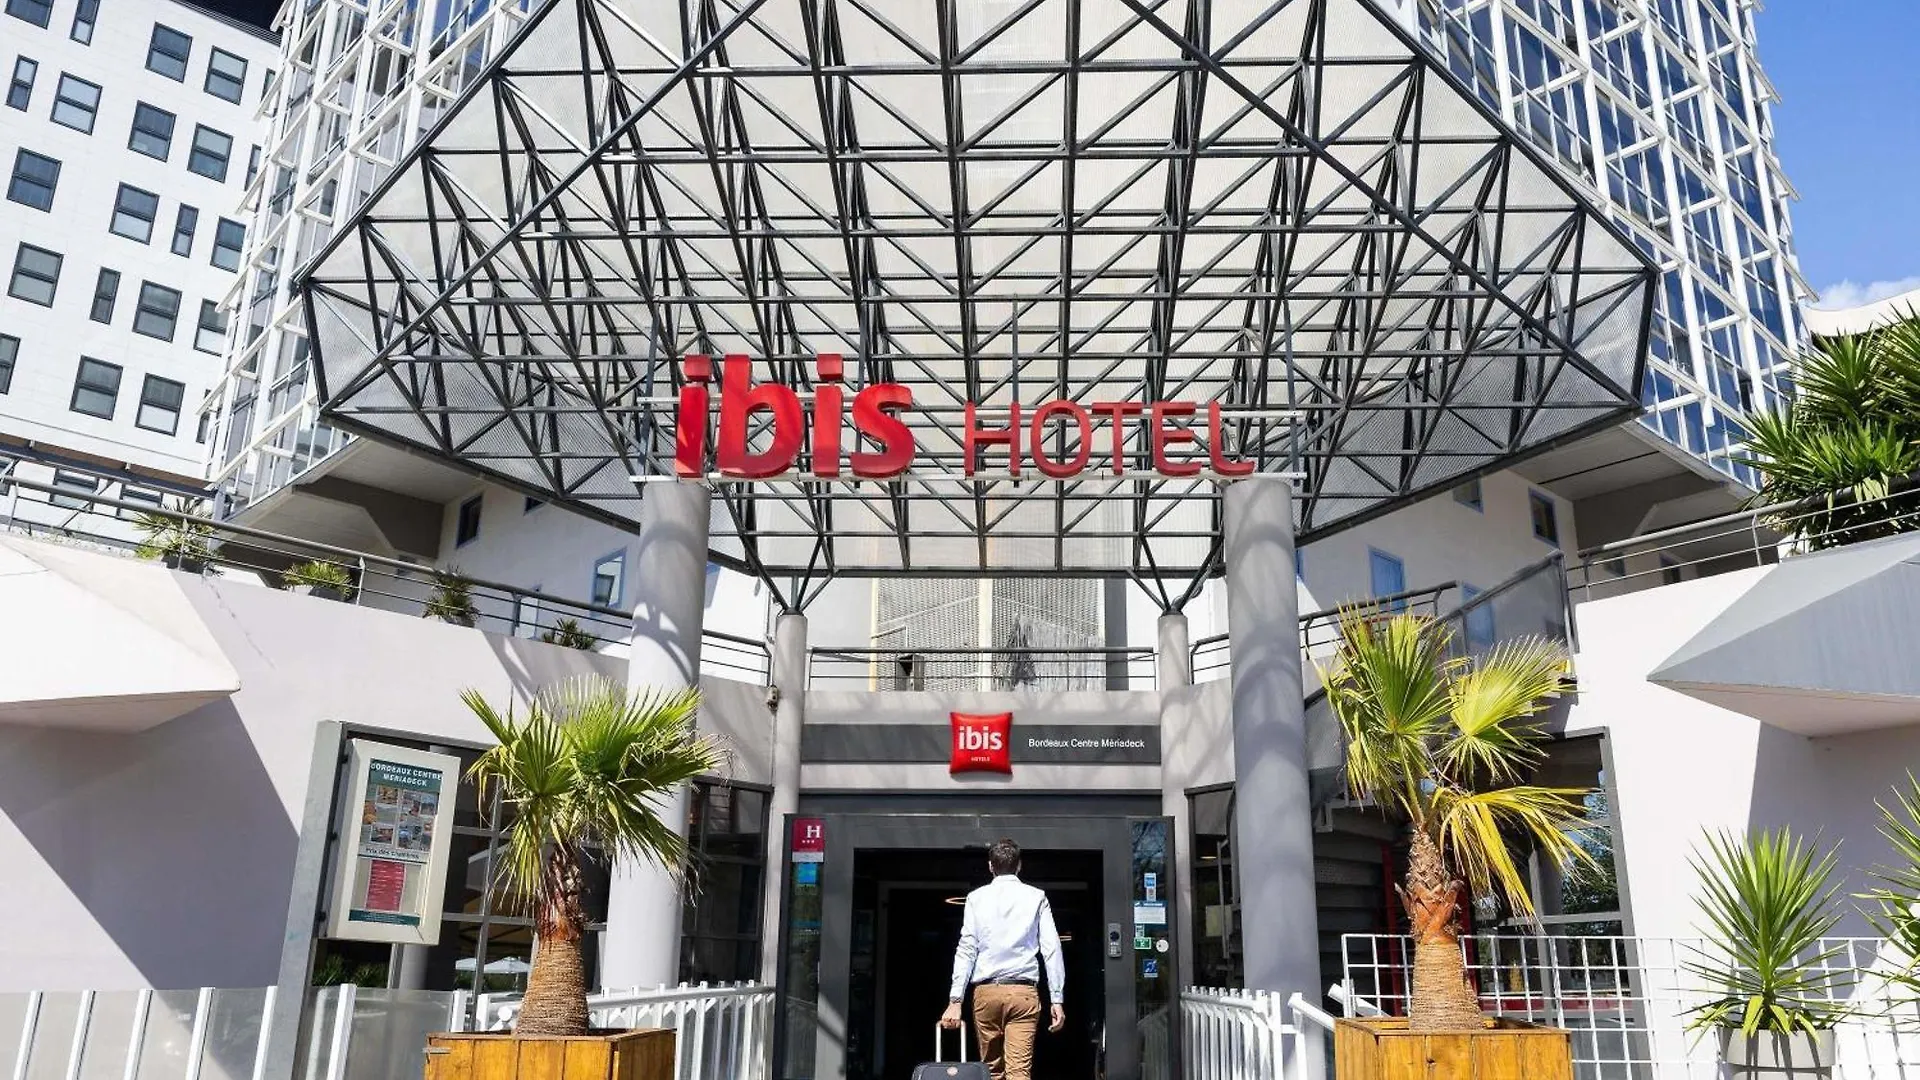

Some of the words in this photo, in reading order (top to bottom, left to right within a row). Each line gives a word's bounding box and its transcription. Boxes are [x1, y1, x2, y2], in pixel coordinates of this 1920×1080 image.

[675, 353, 915, 479] ibis
[965, 399, 1256, 479] HOTEL
[959, 725, 1003, 750] ibis
[1028, 738, 1068, 748] Bordeaux
[1070, 738, 1099, 748] Centre
[806, 825, 821, 838] H
